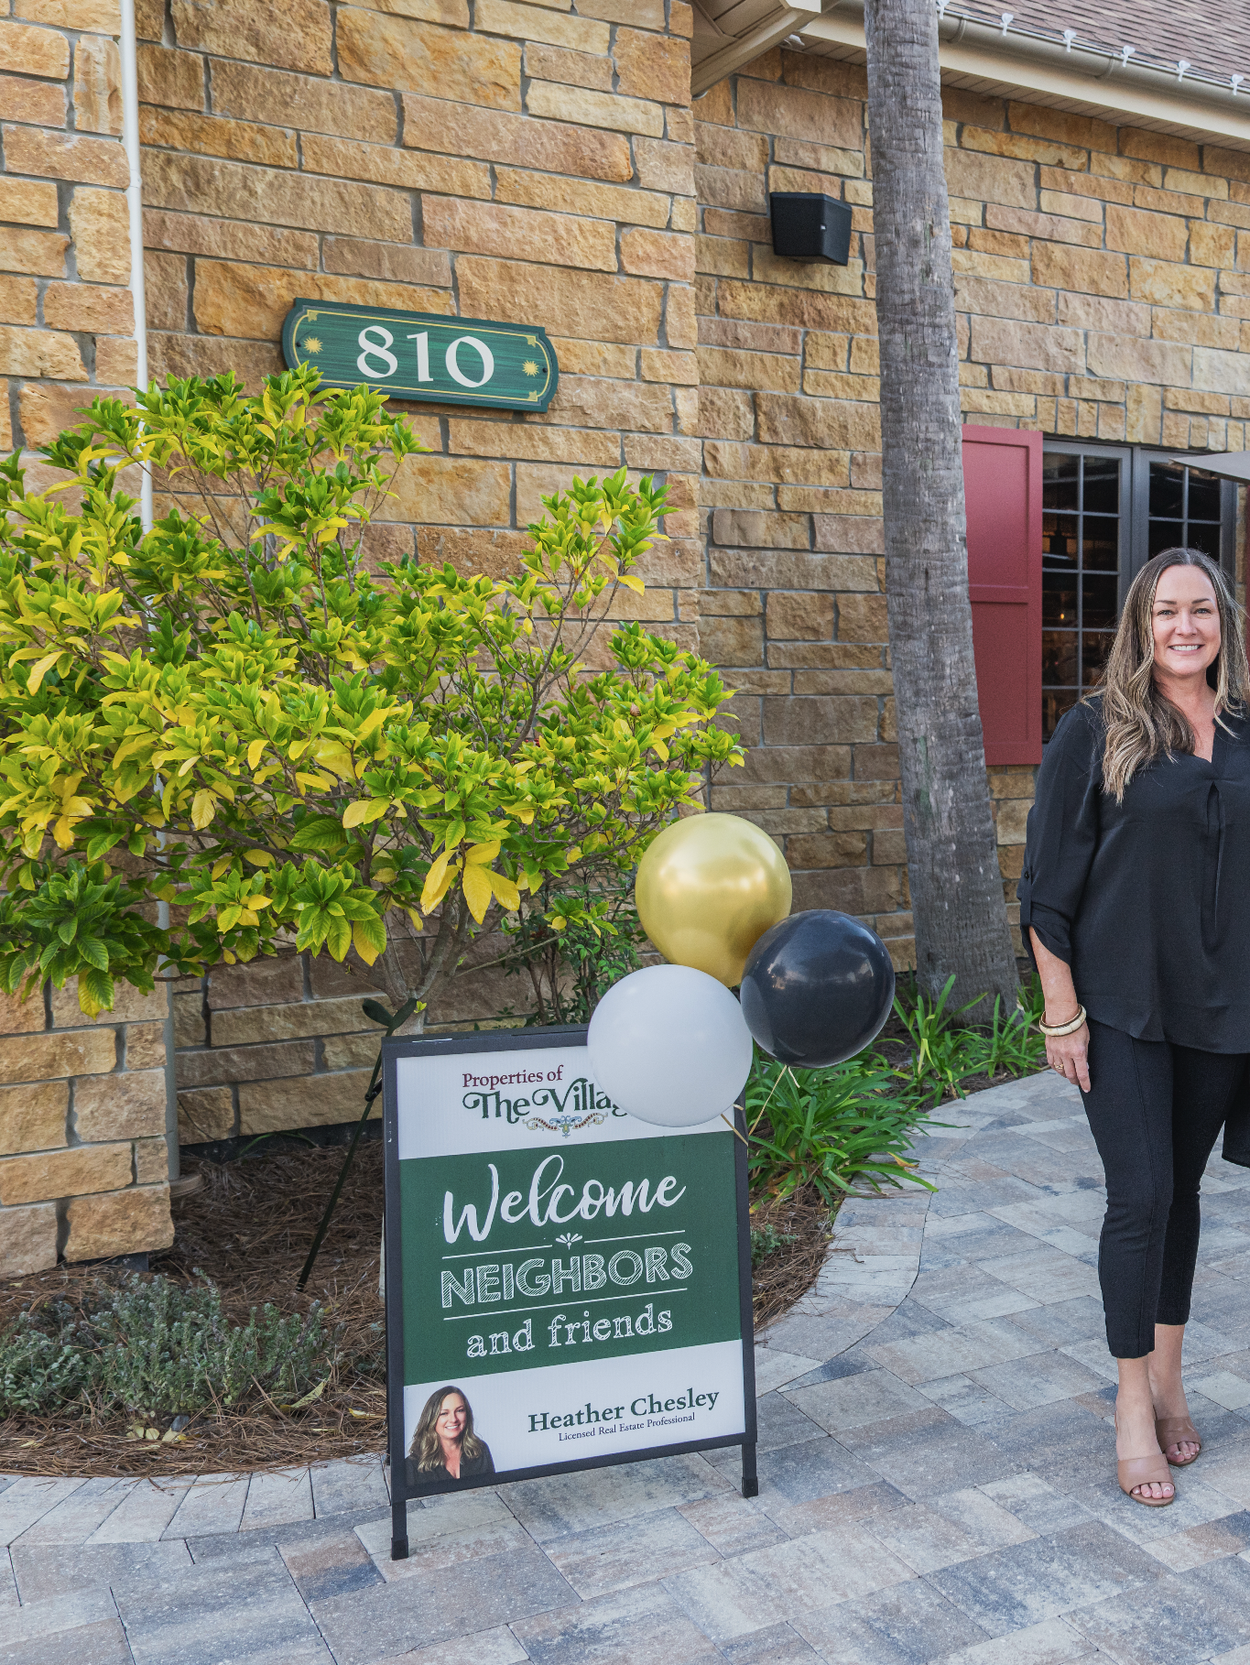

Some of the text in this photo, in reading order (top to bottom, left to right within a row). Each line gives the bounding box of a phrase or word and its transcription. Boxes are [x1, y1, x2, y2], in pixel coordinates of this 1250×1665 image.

[356, 325, 495, 388] 810
[462, 1064, 564, 1090] Properties of
[462, 1077, 628, 1124] The Villa
[442, 1154, 686, 1244] Welcome
[440, 1242, 694, 1309] NEIGHBORS
[466, 1303, 673, 1359] and friends
[528, 1387, 720, 1433] Heather Chesley
[558, 1412, 695, 1441] Licensed Real Estate Professional
